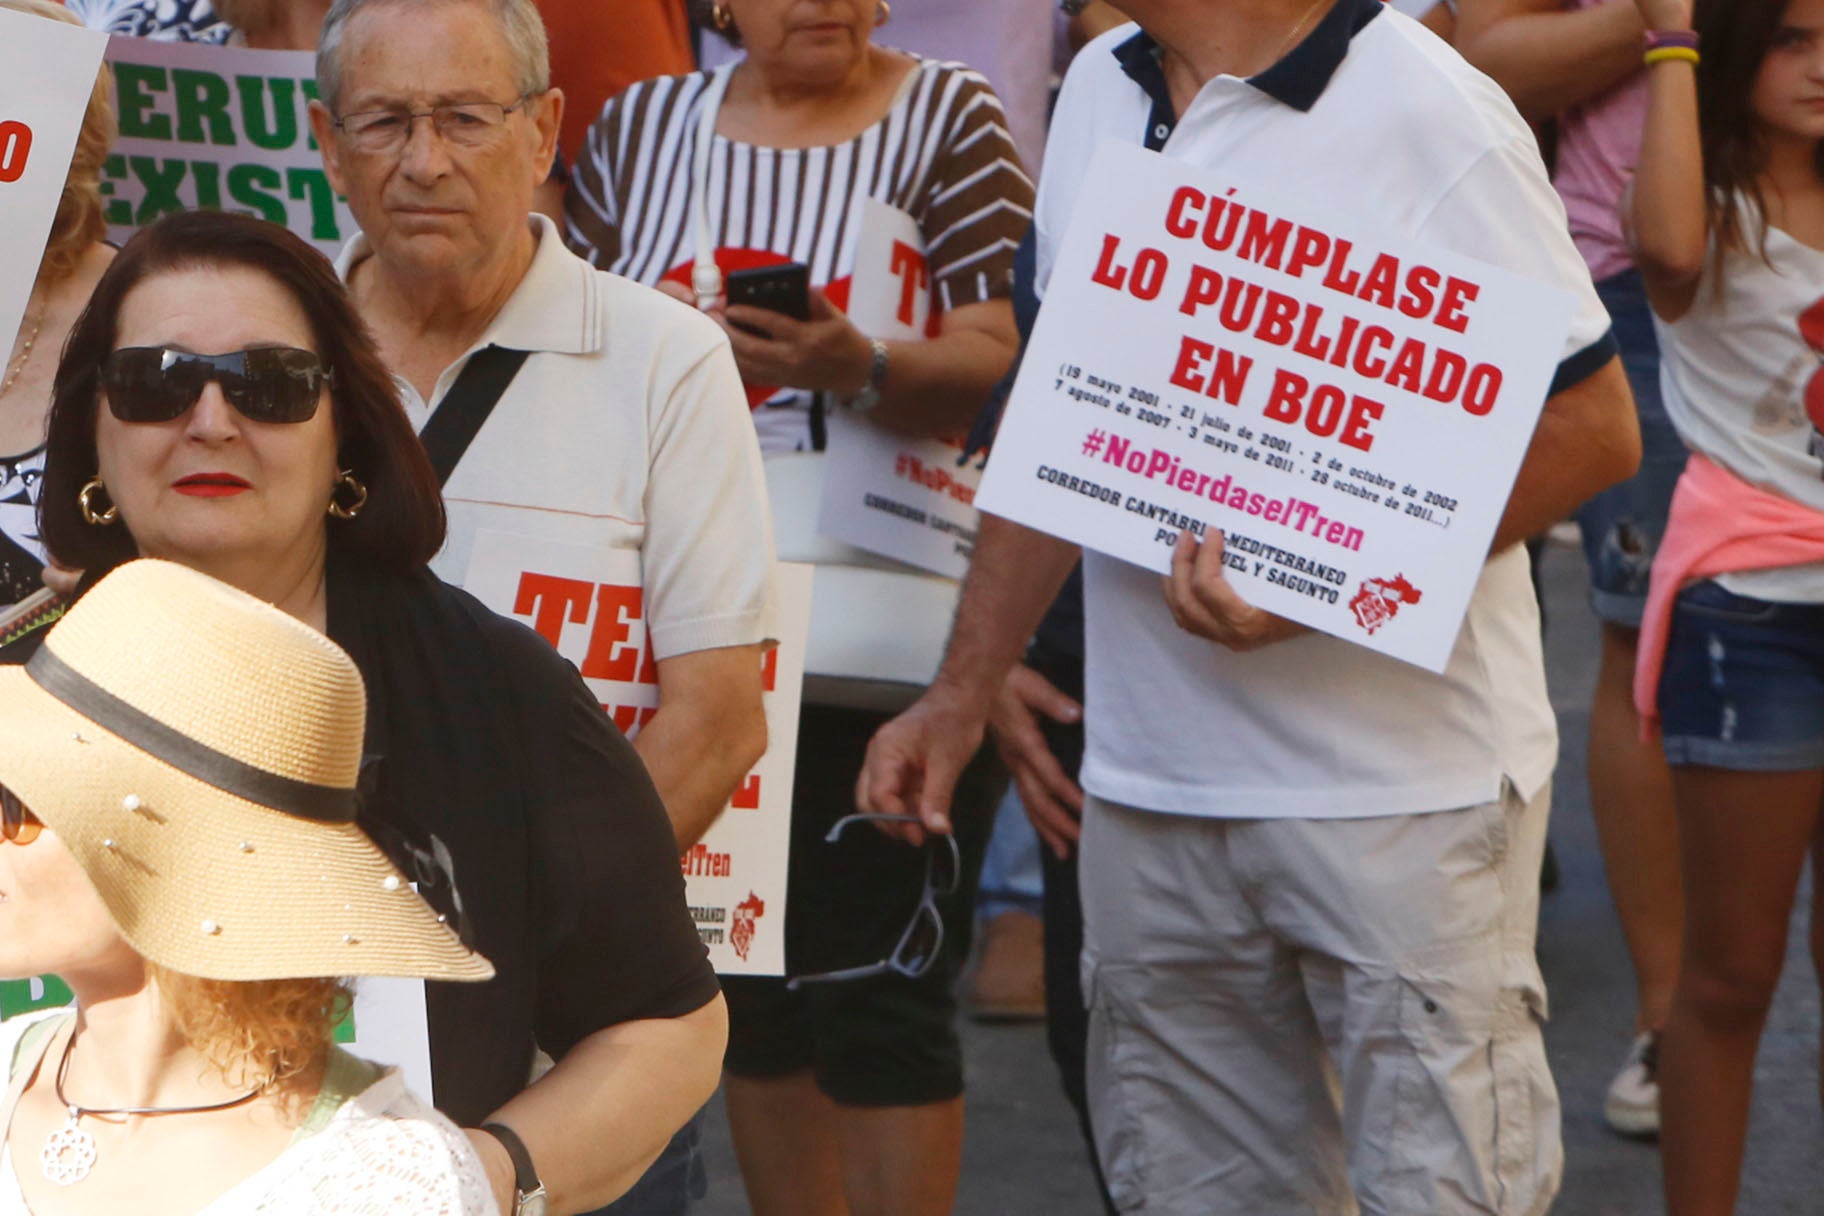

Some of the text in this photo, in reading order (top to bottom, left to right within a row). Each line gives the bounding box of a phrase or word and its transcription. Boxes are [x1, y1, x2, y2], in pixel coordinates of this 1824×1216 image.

[1165, 185, 1480, 334] CÚMPLASE
[1091, 233, 1504, 417] LO PUBLICADO
[1067, 385, 1111, 412] agosto
[1116, 400, 1132, 417] de
[1137, 407, 1171, 429] 2007
[1188, 425, 1198, 440] 3
[1204, 431, 1239, 455] mayo
[1244, 444, 1260, 462] de
[1333, 478, 1379, 504] octubre
[1384, 493, 1401, 511] de
[1087, 373, 1123, 397] mayo
[1200, 411, 1231, 435] julio
[1236, 424, 1253, 441] de
[1312, 449, 1322, 464] 2
[1328, 455, 1345, 473] de
[1349, 465, 1396, 493] octubre
[1403, 481, 1419, 498] de
[1425, 489, 1458, 513] 2002
[1170, 335, 1386, 453] EN BOE
[1036, 464, 1122, 507] CORREDOR
[1082, 427, 1364, 552] #NoPierdaselTren
[1253, 561, 1264, 578] Y
[1266, 566, 1340, 605] SAGUNTO
